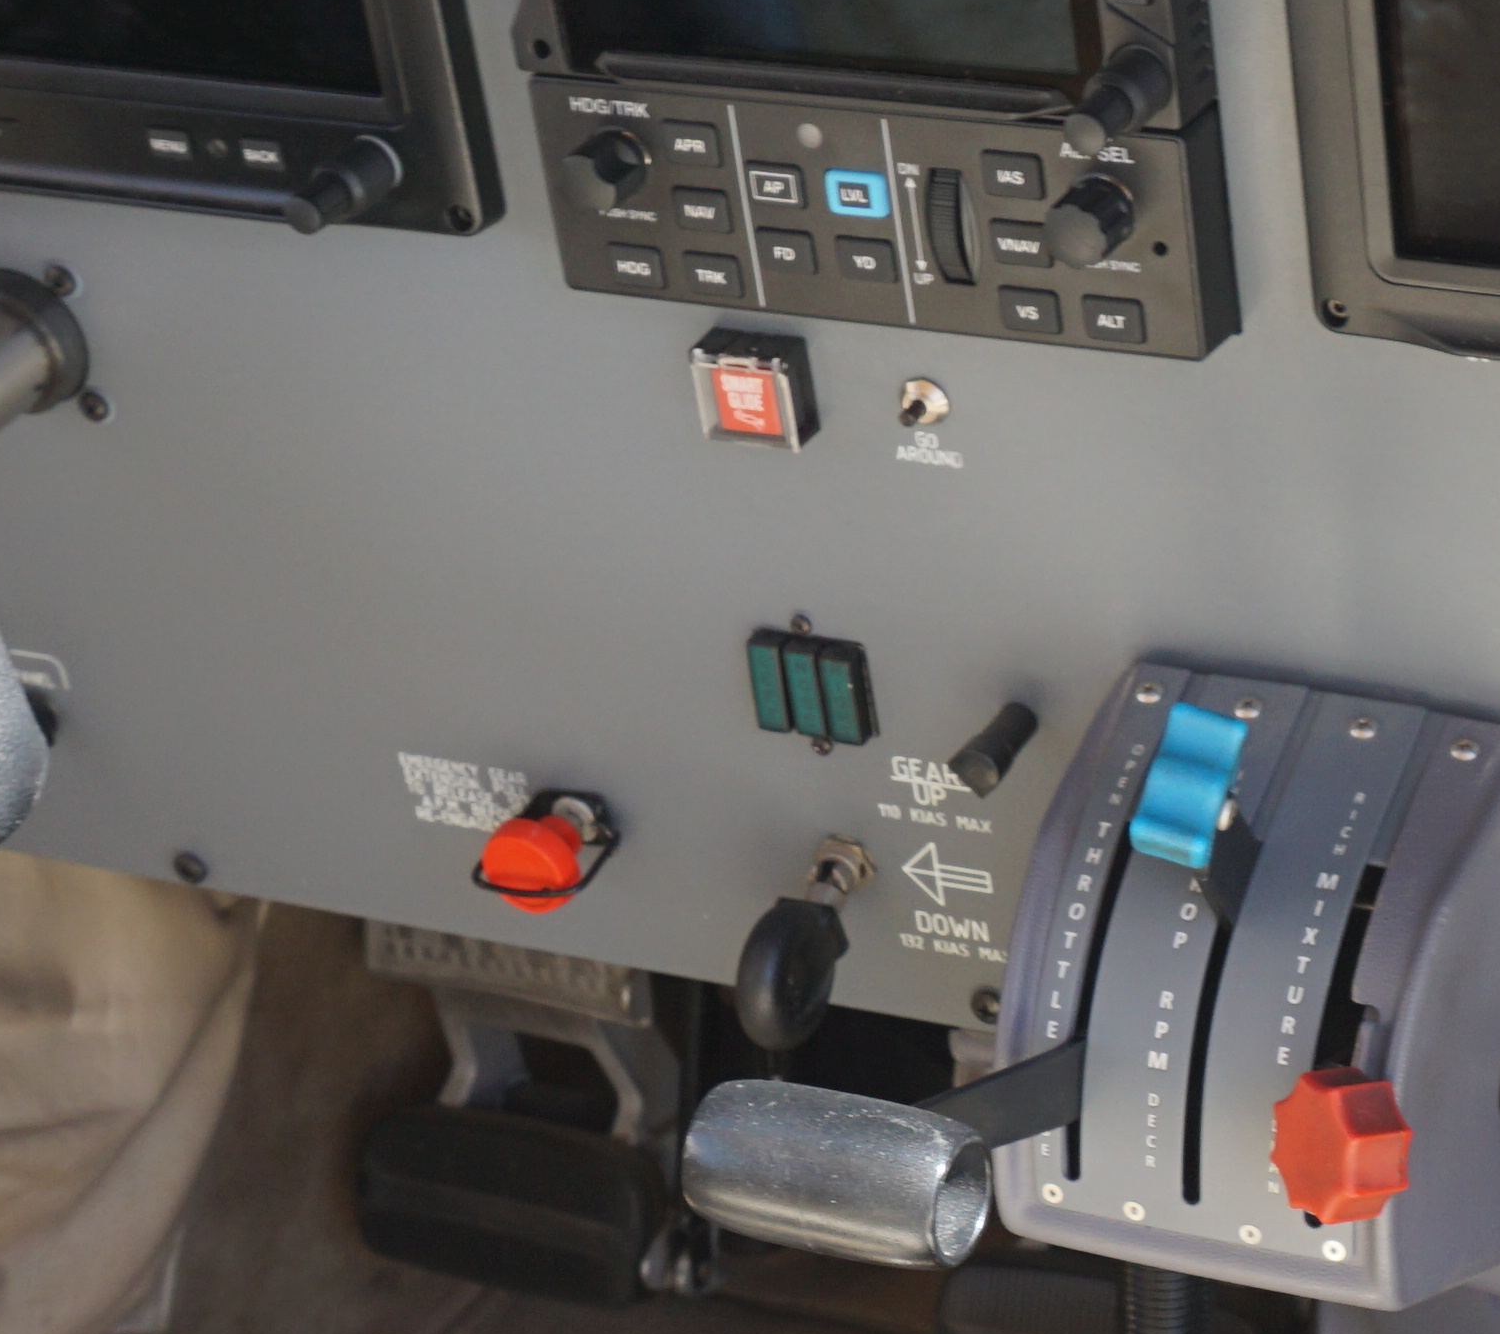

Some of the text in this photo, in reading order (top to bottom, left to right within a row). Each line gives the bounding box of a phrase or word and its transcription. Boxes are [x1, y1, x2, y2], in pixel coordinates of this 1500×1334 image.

[568, 96, 650, 117] HDG/TRK
[674, 138, 706, 154] APR
[1097, 146, 1136, 164] SEL
[996, 169, 1025, 185] IAS
[763, 180, 785, 194] AP
[840, 188, 869, 203] LVL
[684, 204, 716, 220] NAV
[773, 246, 796, 261] FD
[997, 237, 1040, 254] VNAV
[616, 259, 652, 276] HDG
[852, 255, 877, 270] YD
[695, 268, 728, 285] TRK
[913, 271, 935, 285] UP
[1015, 305, 1040, 320] VS
[1097, 313, 1126, 329] ALT
[914, 431, 940, 449] GO
[896, 445, 963, 468] AROUND
[911, 780, 948, 806] UP
[909, 807, 949, 827] KIAS
[955, 815, 993, 834] MAX
[1172, 875, 1204, 950] ROP
[914, 909, 991, 943] DOWN
[1045, 821, 1113, 1040] THROTTLE
[932, 938, 971, 958] KIAS
[1275, 872, 1340, 1067] MIXTURE
[1148, 990, 1175, 1071] RPM
[1145, 1093, 1161, 1168] DECR
